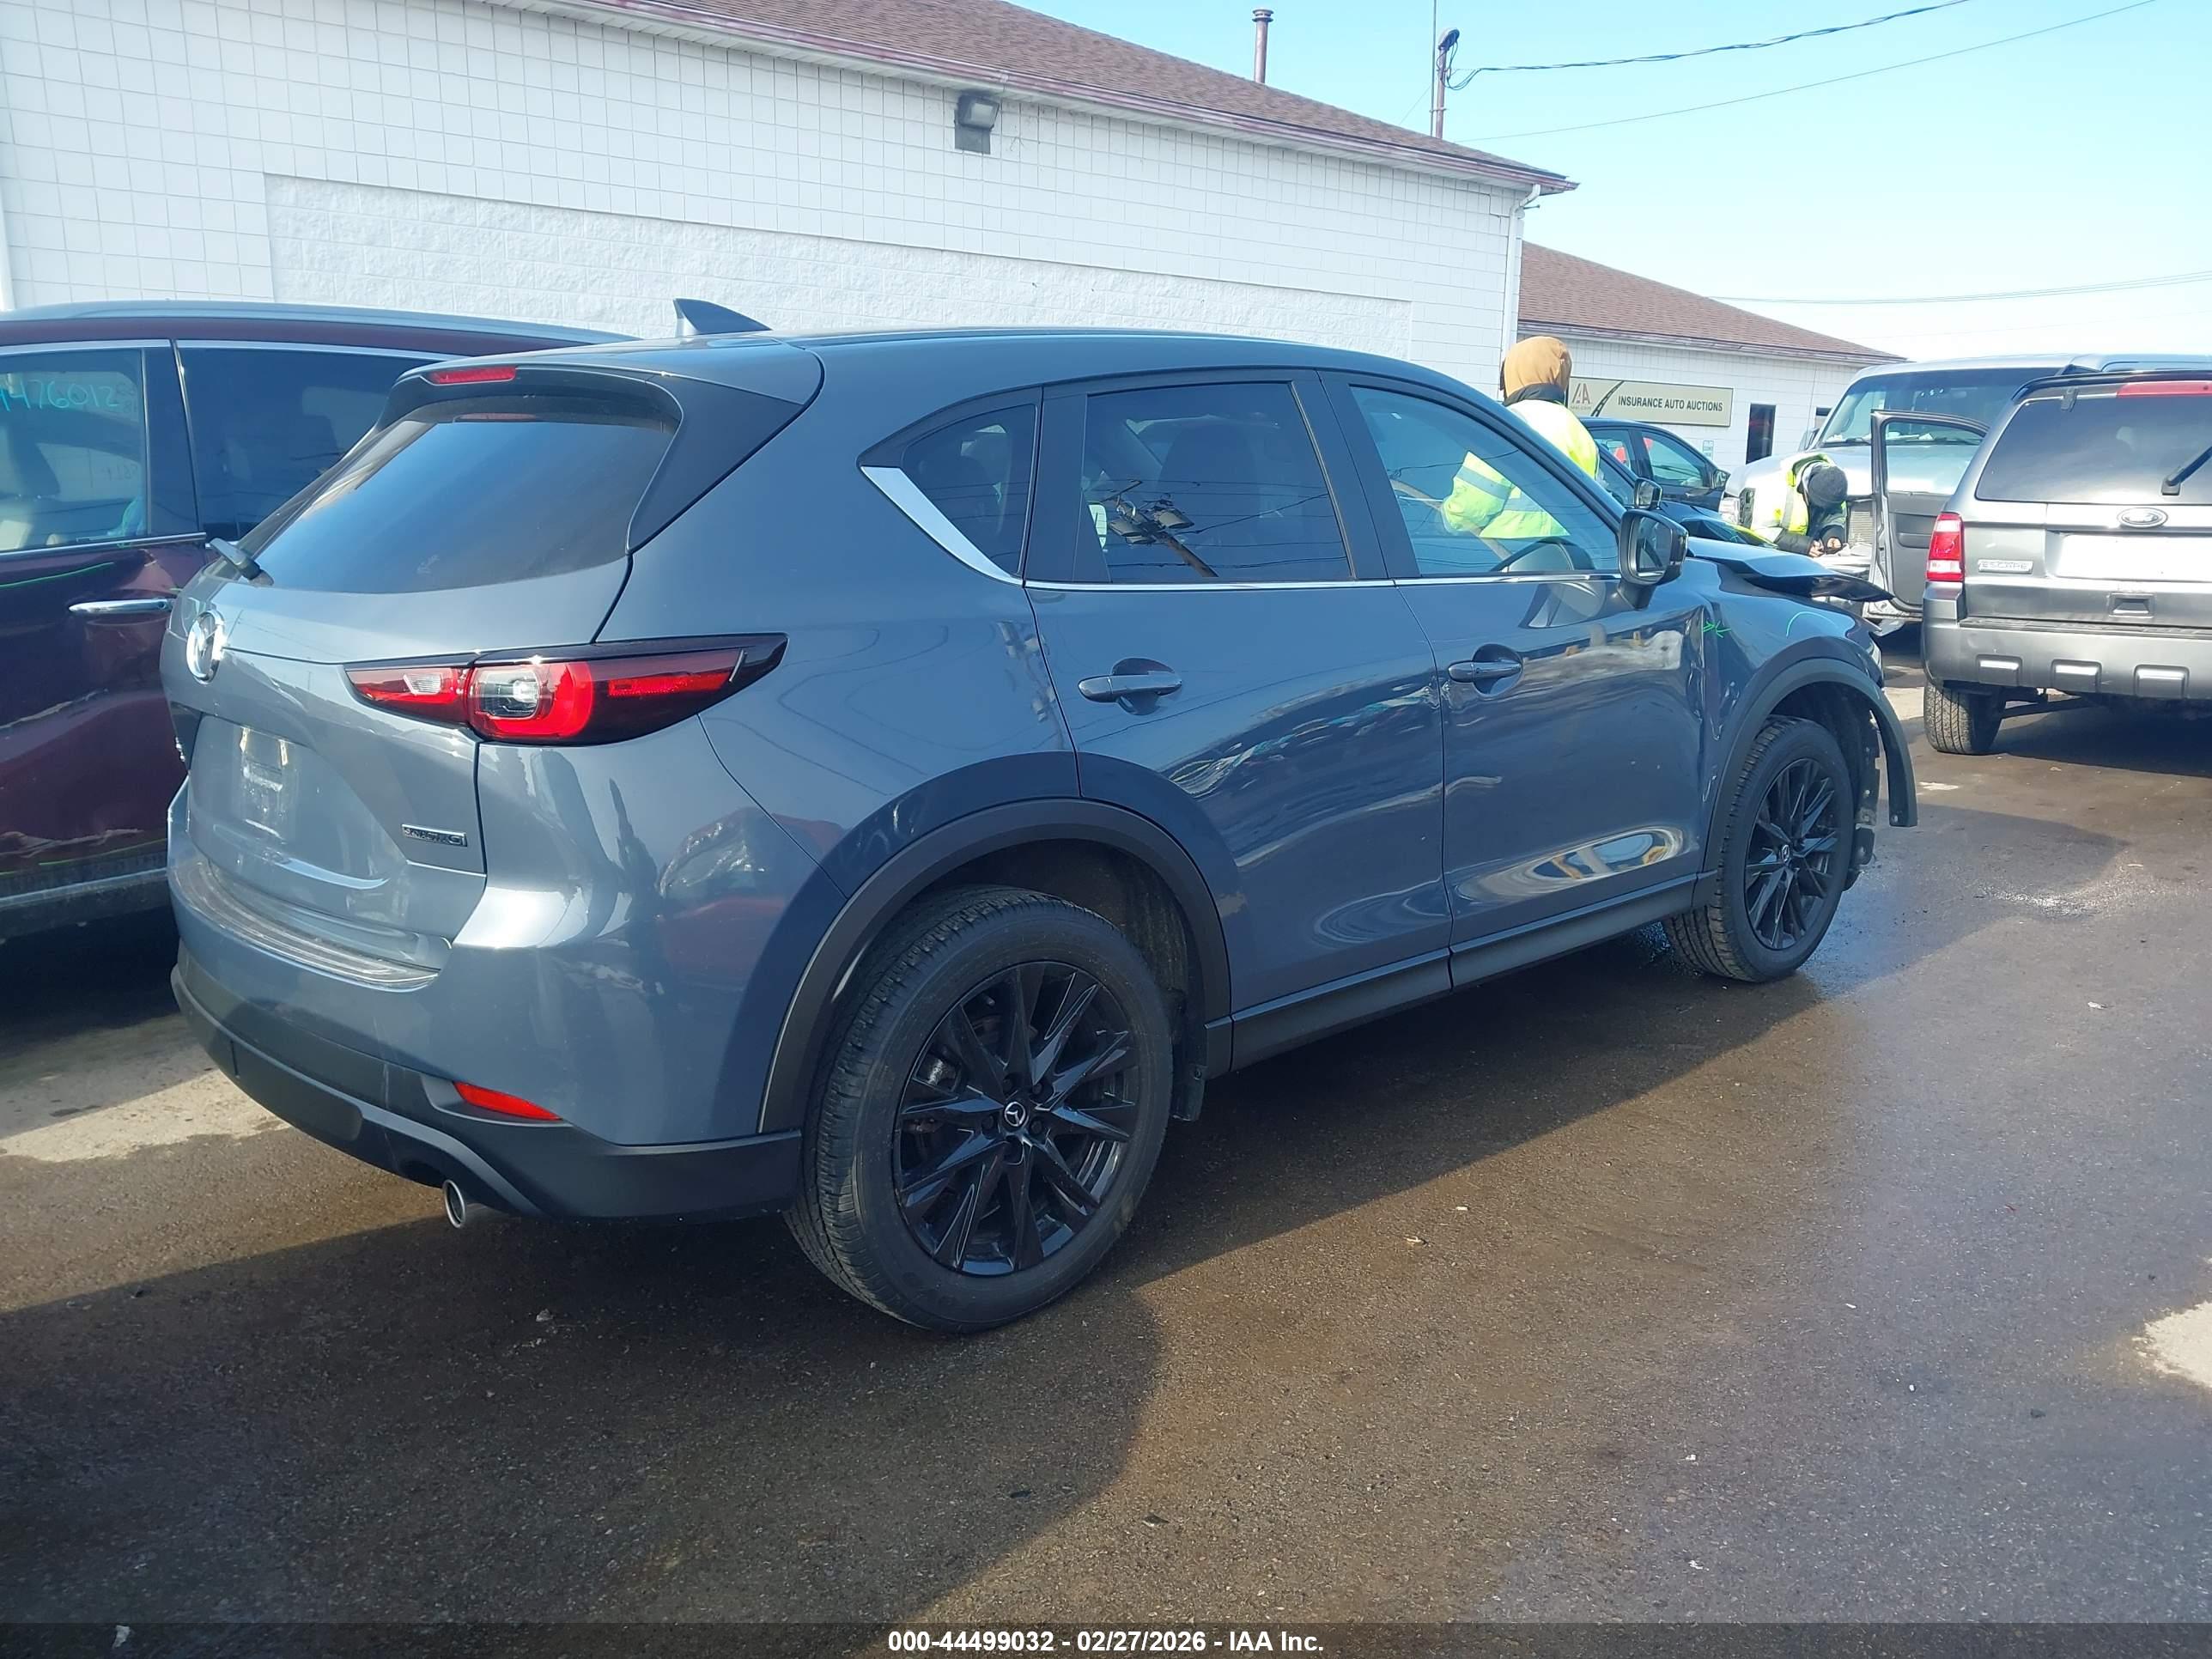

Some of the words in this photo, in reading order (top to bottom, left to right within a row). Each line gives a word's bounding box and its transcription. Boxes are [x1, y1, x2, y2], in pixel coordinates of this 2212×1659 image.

[1618, 396, 1663, 409] INSURANCE
[1664, 398, 1684, 410] AUTO
[1686, 400, 1723, 411] AUCTIONS
